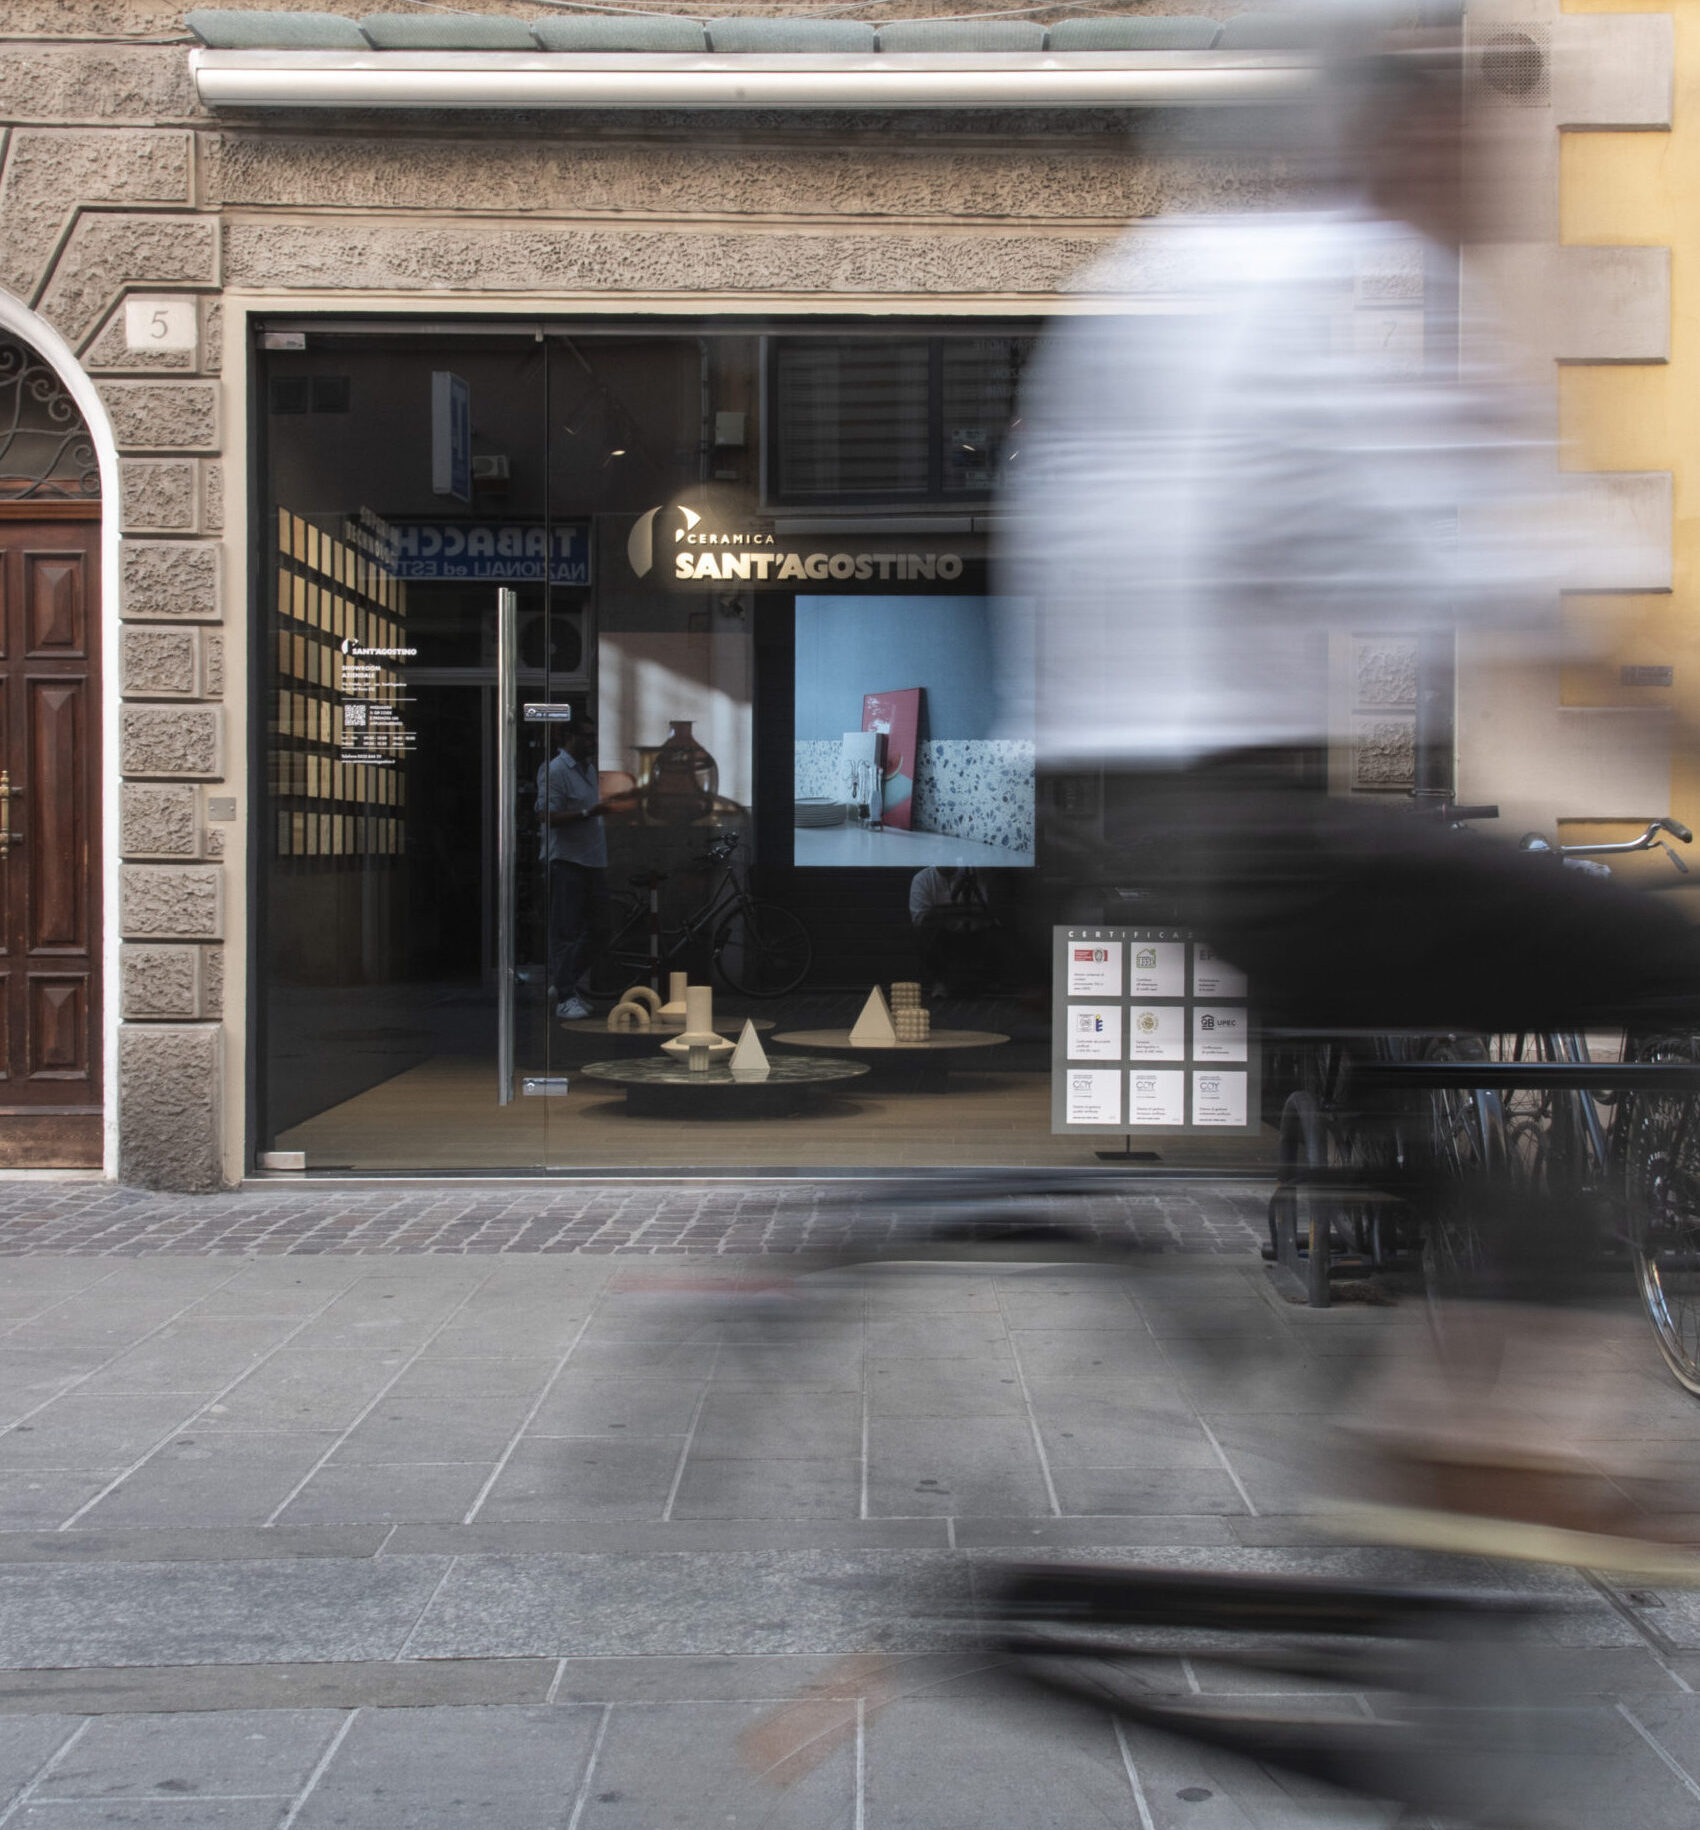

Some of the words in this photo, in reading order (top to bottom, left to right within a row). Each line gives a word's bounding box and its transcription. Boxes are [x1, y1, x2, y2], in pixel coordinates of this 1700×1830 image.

[151, 310, 169, 339] 5
[687, 534, 775, 545] CERAMICA
[675, 552, 964, 580] SANT'AGOSTINO
[352, 648, 417, 656] SANT'AGOSTINO
